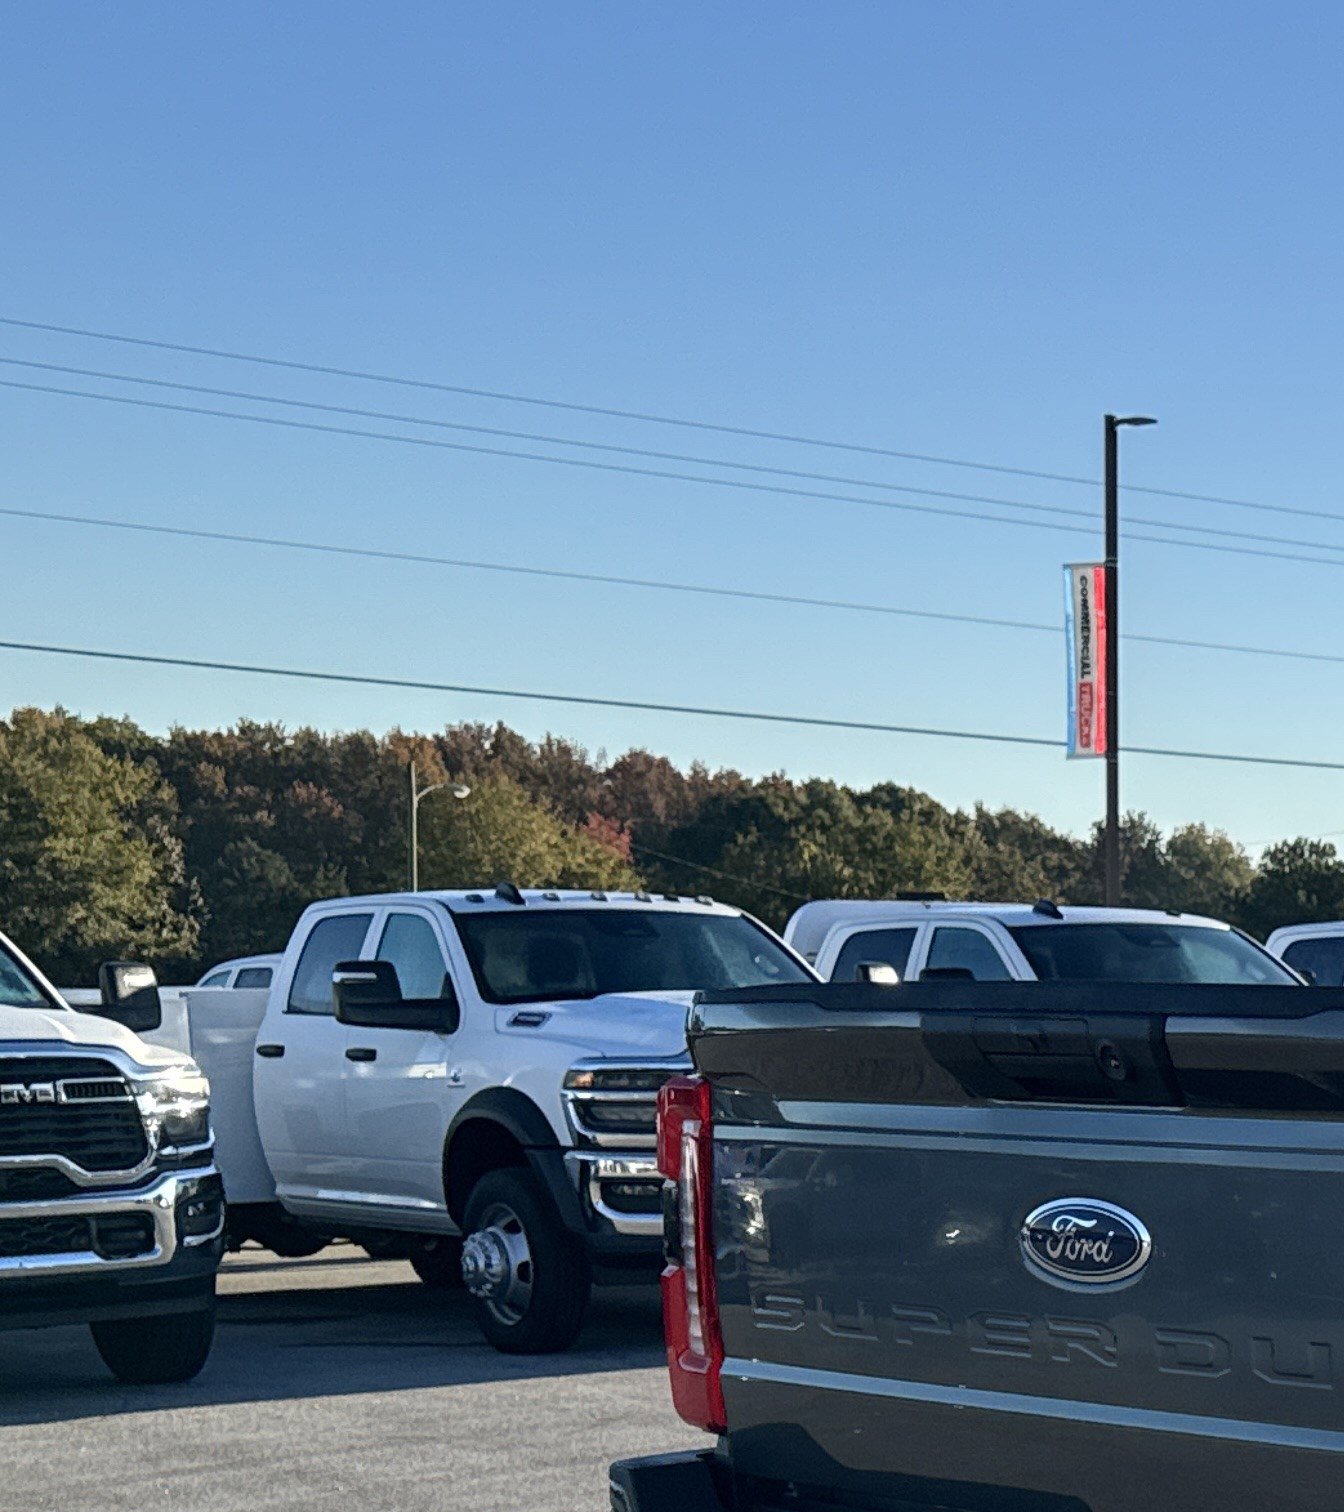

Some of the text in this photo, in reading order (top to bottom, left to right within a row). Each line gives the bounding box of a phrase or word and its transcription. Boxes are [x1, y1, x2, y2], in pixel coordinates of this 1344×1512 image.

[1079, 575, 1092, 679] COMMERCIAL
[1045, 1214, 1115, 1263] Ford
[750, 1288, 1119, 1368] SUPER
